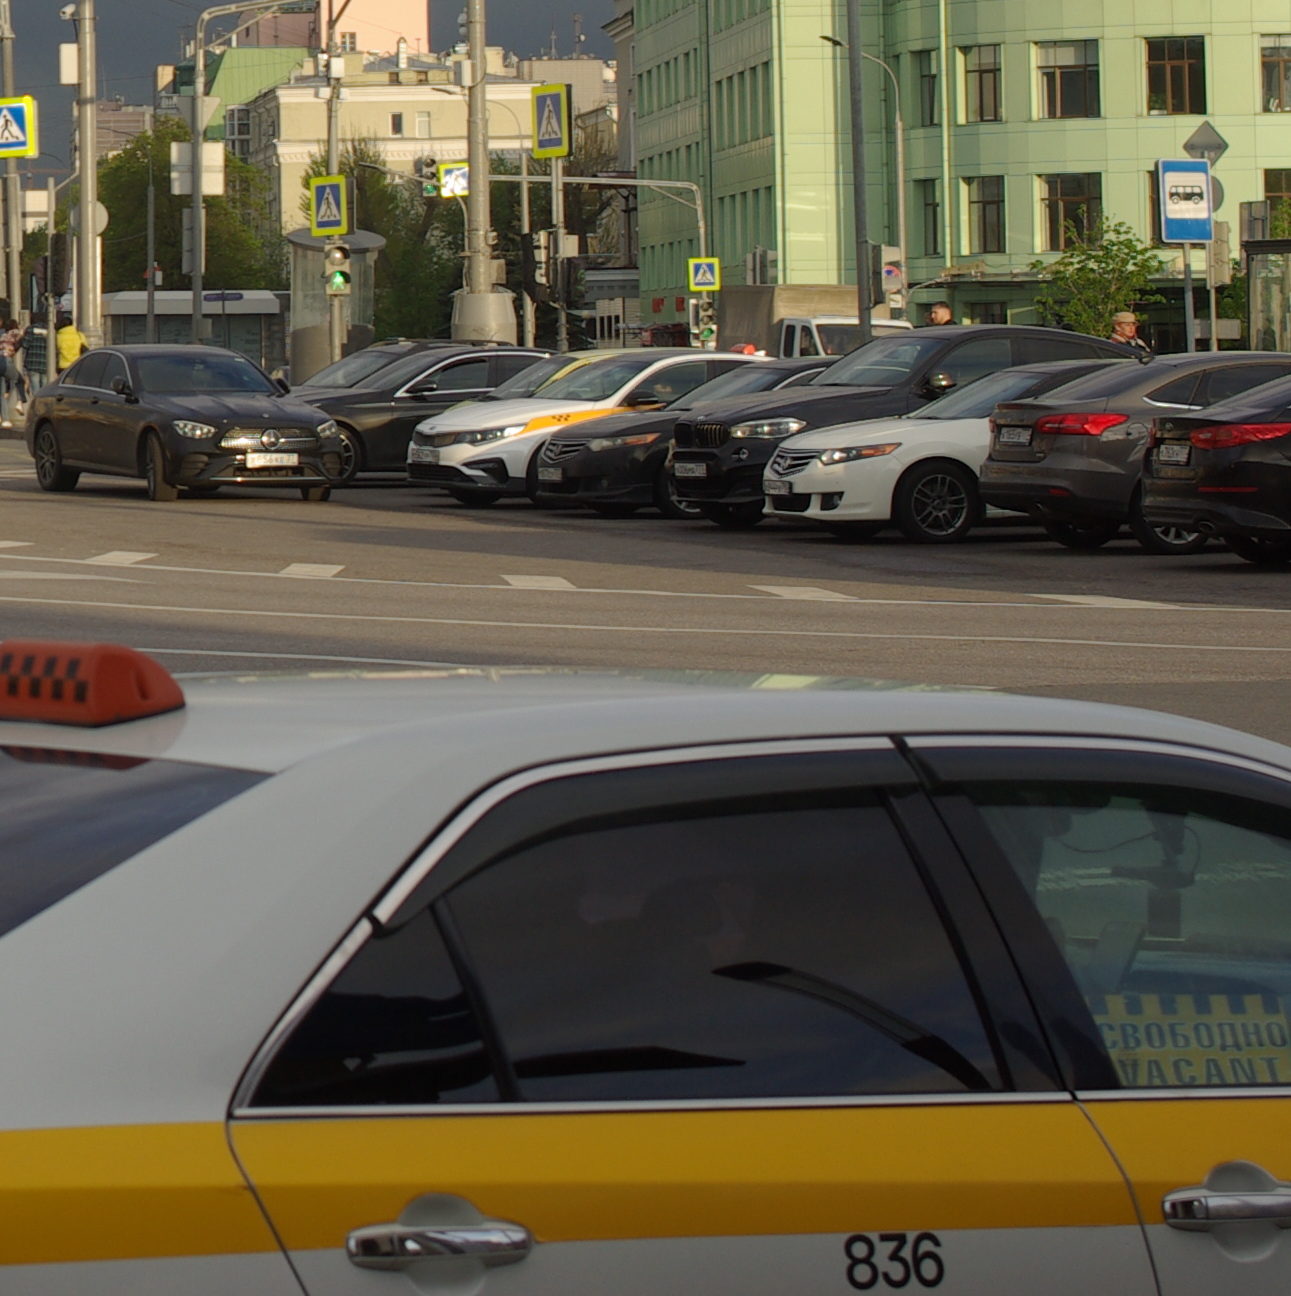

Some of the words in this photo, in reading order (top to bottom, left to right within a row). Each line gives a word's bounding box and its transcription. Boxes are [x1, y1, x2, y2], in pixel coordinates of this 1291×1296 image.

[1098, 1021, 1287, 1052] СВОБОДНО
[1118, 1056, 1280, 1086] VACANT
[844, 1231, 944, 1291] 836
